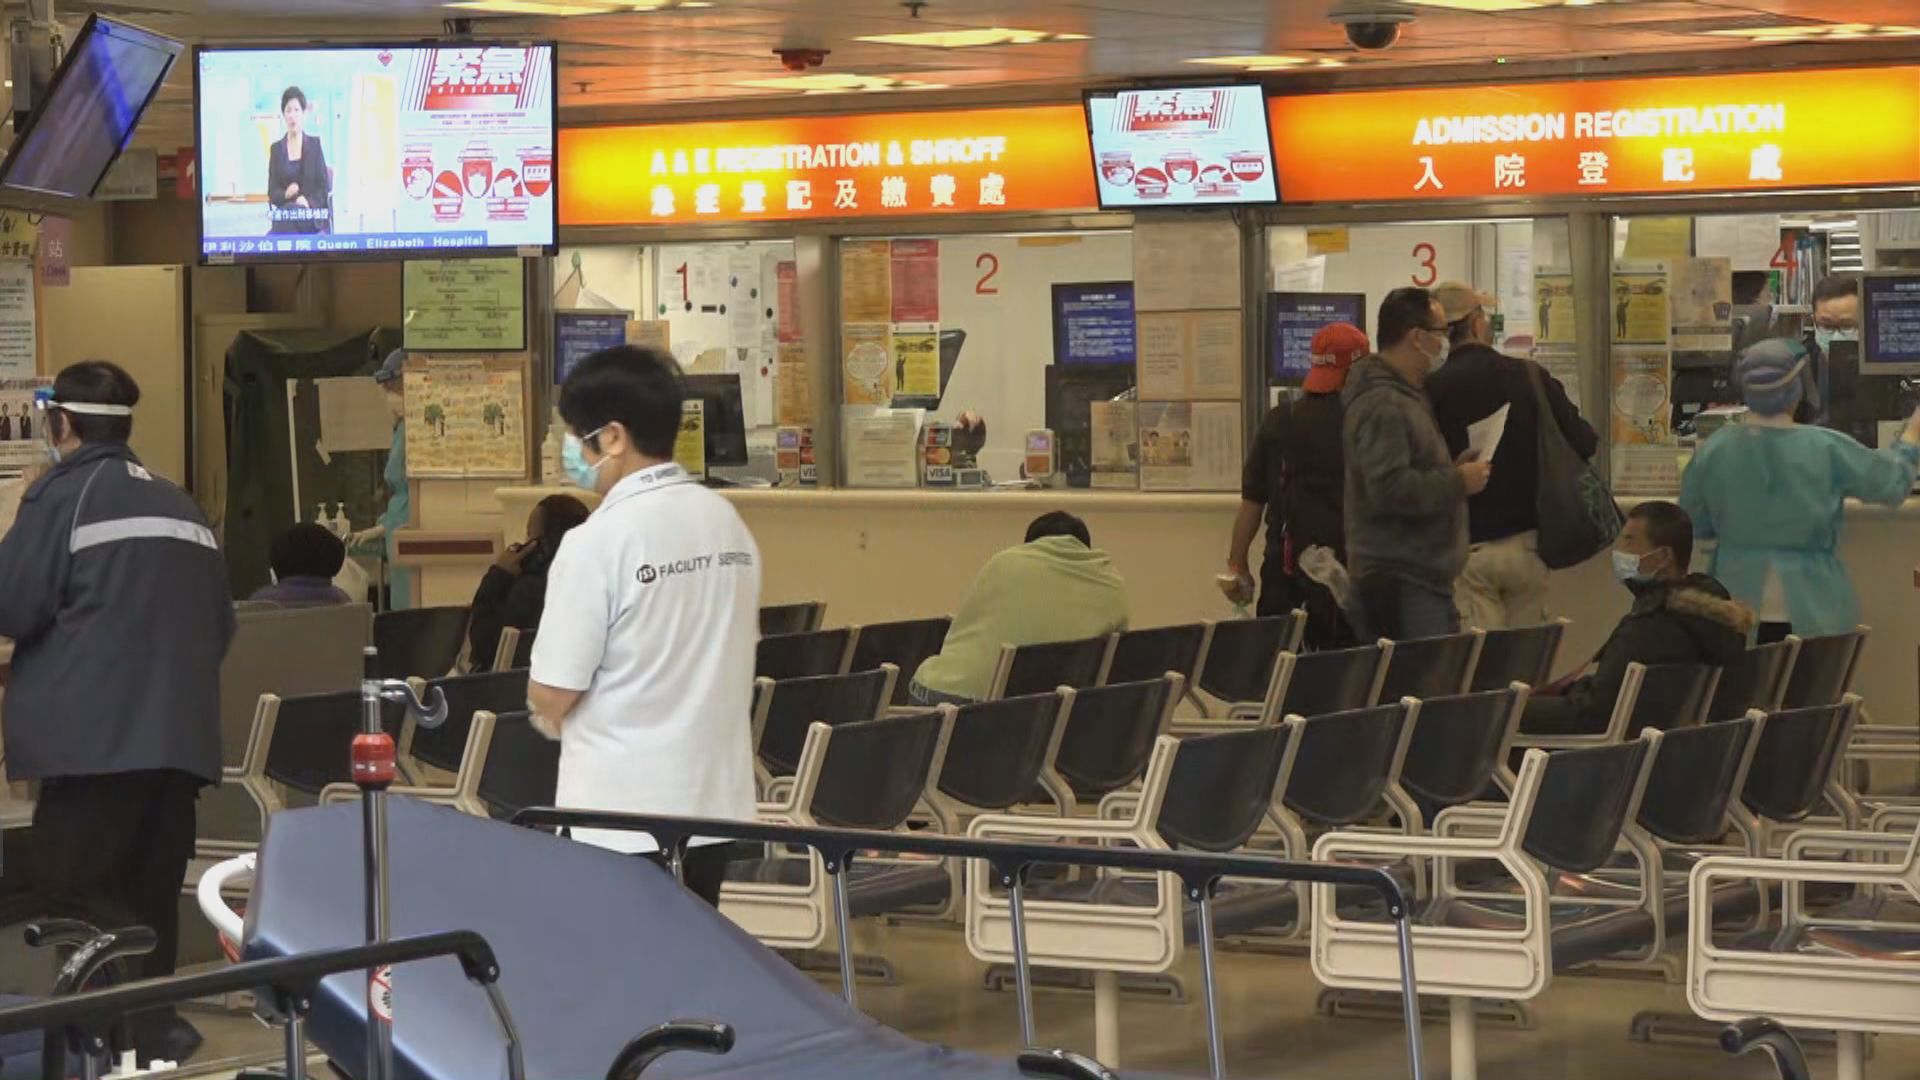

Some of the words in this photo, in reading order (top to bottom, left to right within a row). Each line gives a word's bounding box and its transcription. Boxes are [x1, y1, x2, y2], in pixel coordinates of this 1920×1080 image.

[1412, 113, 1565, 145] ADMISSION
[1574, 103, 1784, 139] REGISTRATION
[651, 150, 668, 176] A
[717, 142, 880, 173] REGISTRATION
[910, 136, 1006, 166] SHROFF
[317, 239, 357, 250] Queen
[366, 237, 424, 249] Elizabeth
[433, 236, 483, 248] Hospital
[1770, 232, 1798, 275] 4
[676, 261, 687, 301] 1
[976, 253, 998, 295] 2
[1412, 243, 1436, 288] 3
[928, 468, 951, 478] VISA
[659, 554, 713, 578] FACILITY
